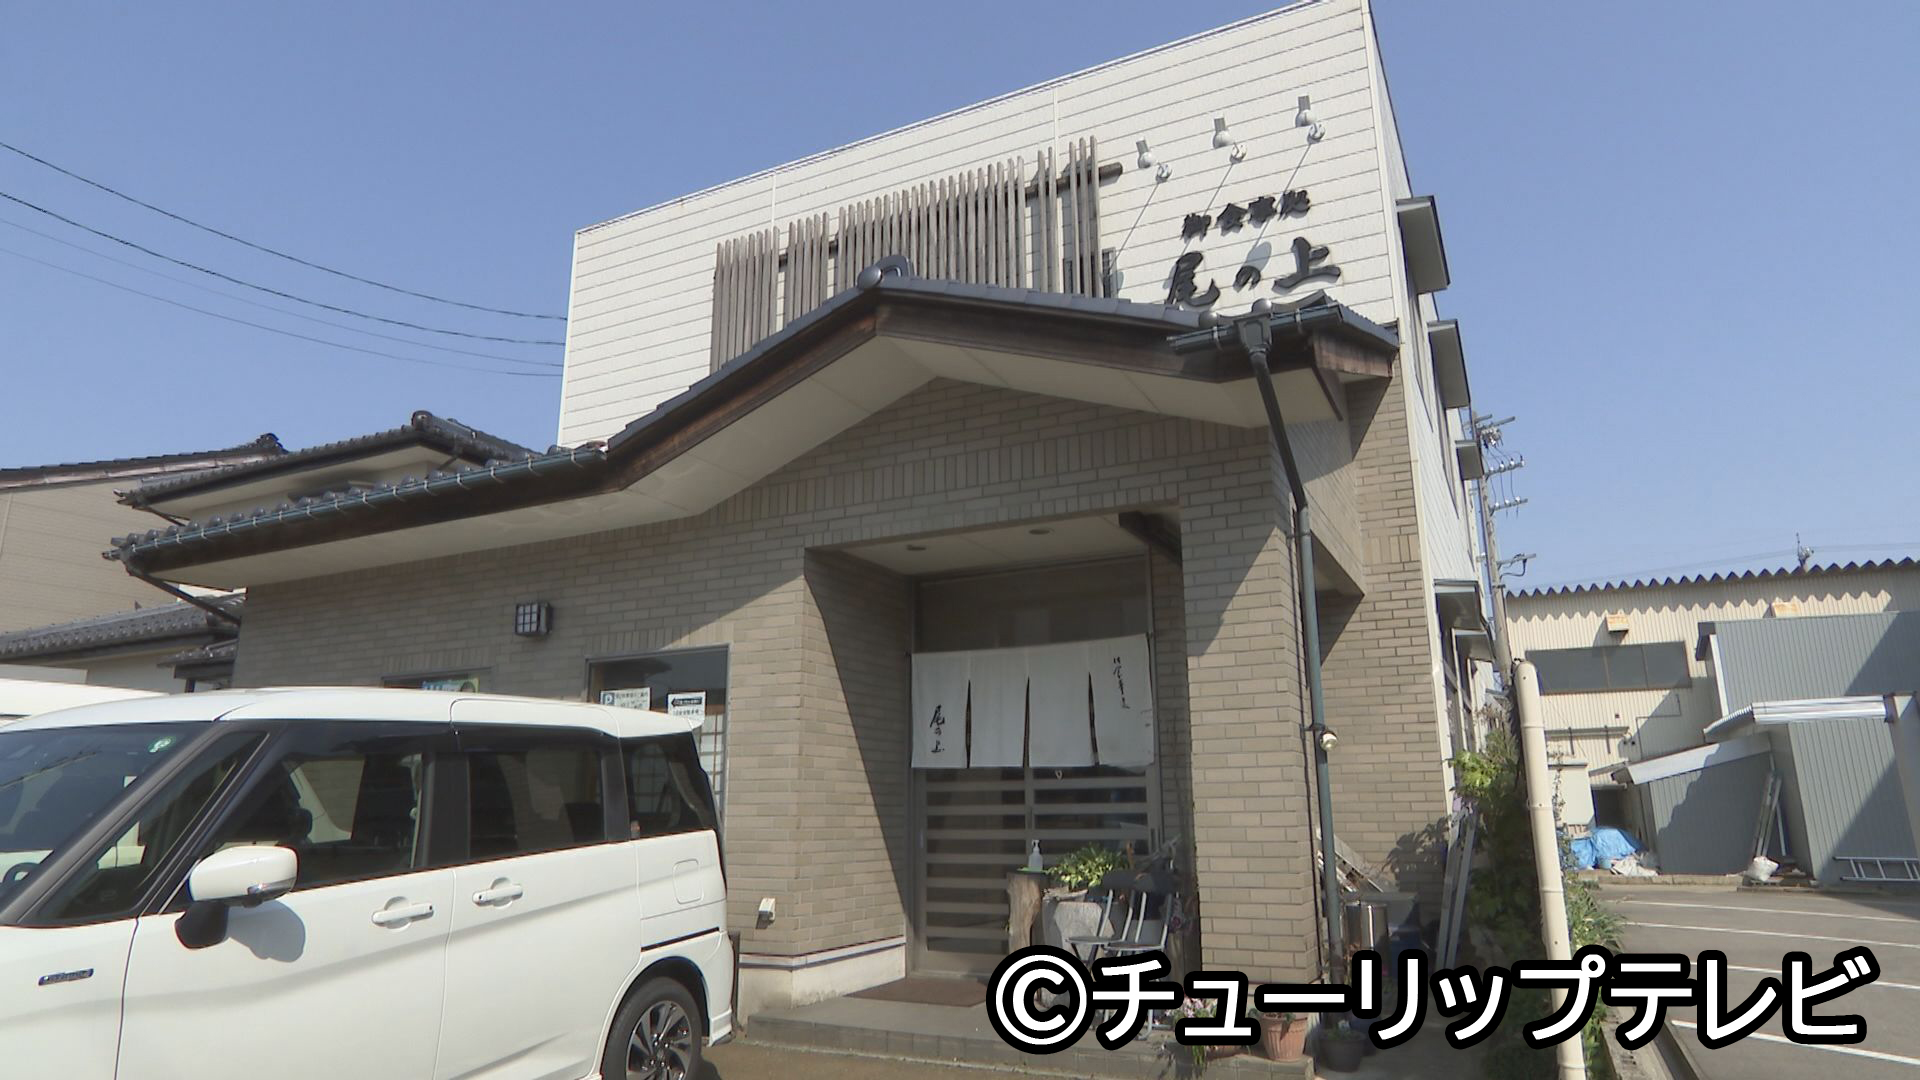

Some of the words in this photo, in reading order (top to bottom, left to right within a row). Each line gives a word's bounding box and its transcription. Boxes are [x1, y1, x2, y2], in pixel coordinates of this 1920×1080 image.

[1165, 236, 1341, 306] 尾の上
[929, 704, 945, 753] 尾の上
